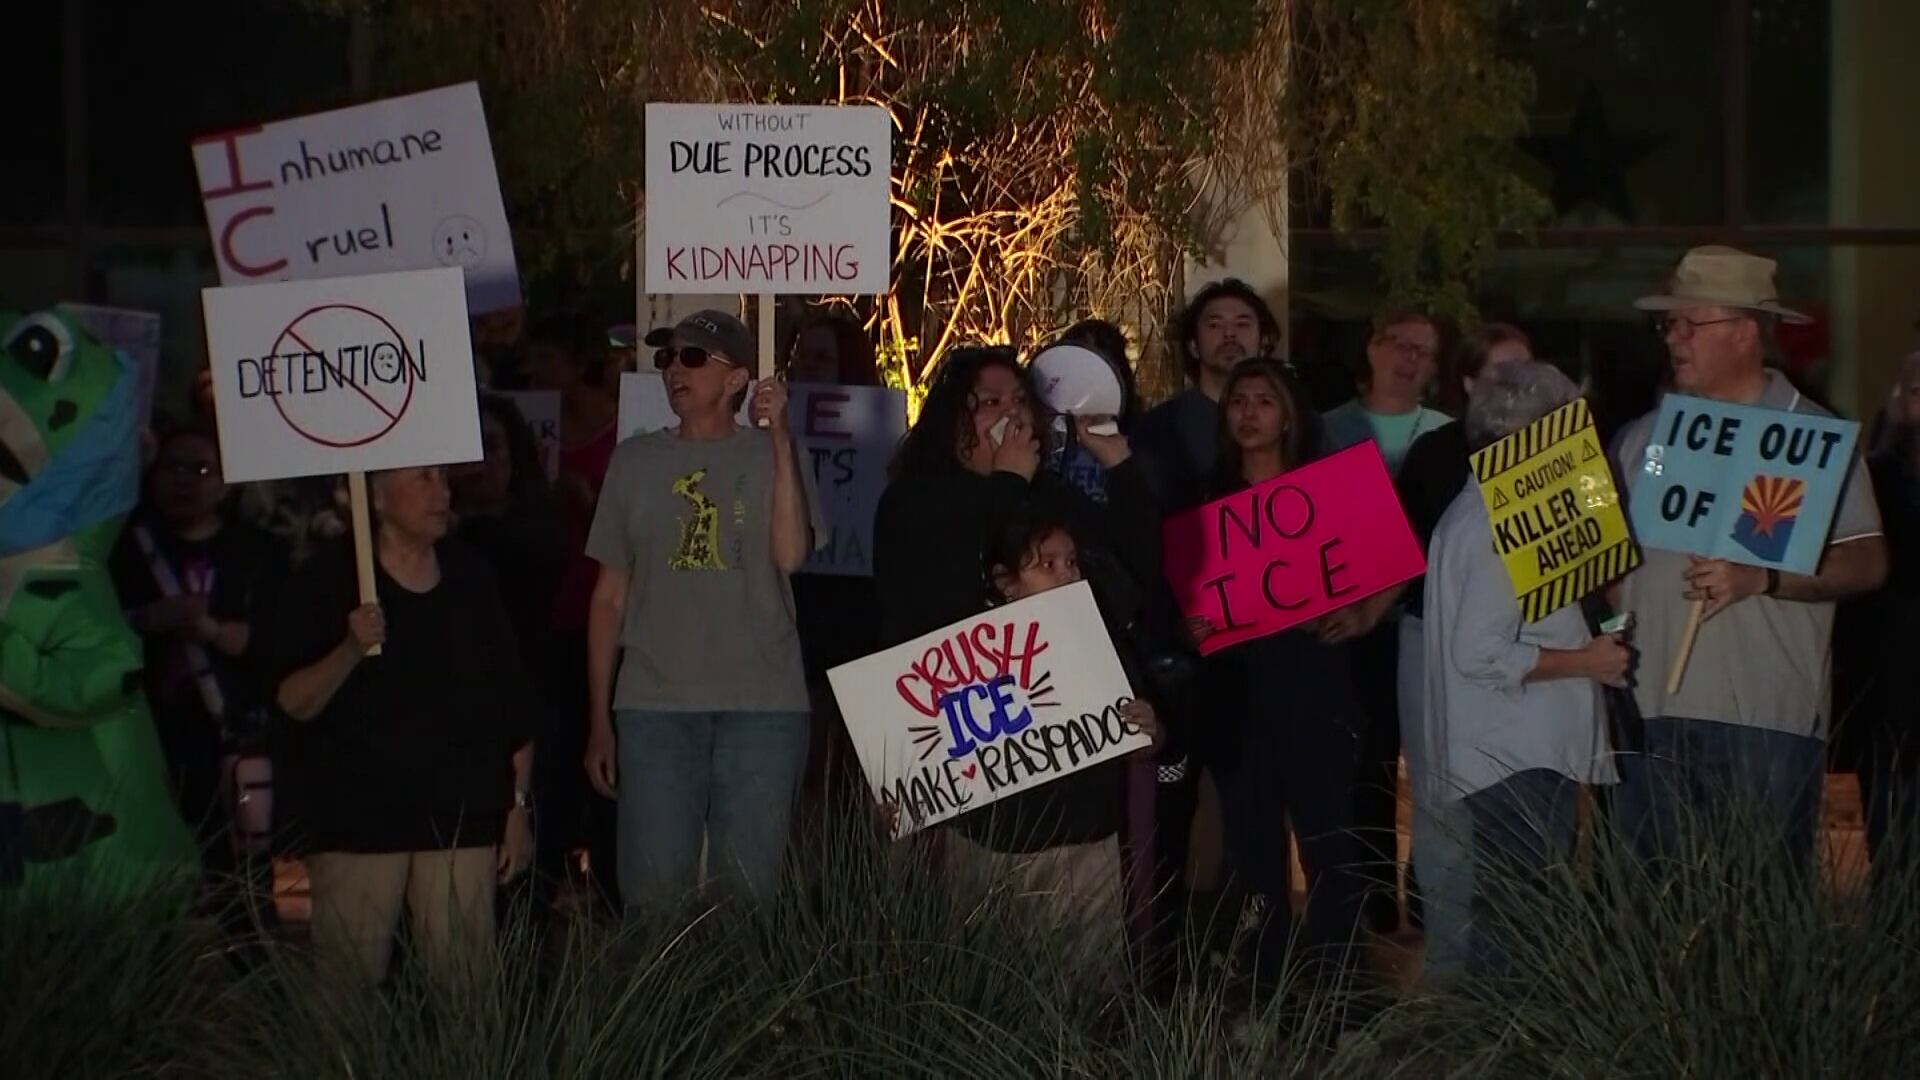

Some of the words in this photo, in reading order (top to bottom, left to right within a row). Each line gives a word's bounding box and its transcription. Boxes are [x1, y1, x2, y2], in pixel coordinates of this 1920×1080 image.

[717, 112, 811, 132] WITHOUT
[670, 141, 732, 174] DUE
[744, 143, 872, 178] PROCESS
[220, 202, 394, 278] Cruel
[748, 214, 793, 237] IT'S
[666, 244, 859, 282] KIDNAPPING
[237, 339, 427, 399] DETENTION
[1667, 410, 1742, 457] ICE
[1759, 423, 1842, 469] OUT
[1514, 450, 1578, 498] CAUTION!
[1218, 483, 1317, 561] NO
[1494, 488, 1582, 555] KILLER
[1661, 484, 1717, 528] OF
[1535, 516, 1603, 577] AHEAD
[1200, 535, 1360, 630] ICE
[895, 621, 1049, 718] CRUSH
[938, 674, 1033, 757] ICE
[881, 758, 974, 823] MAKE
